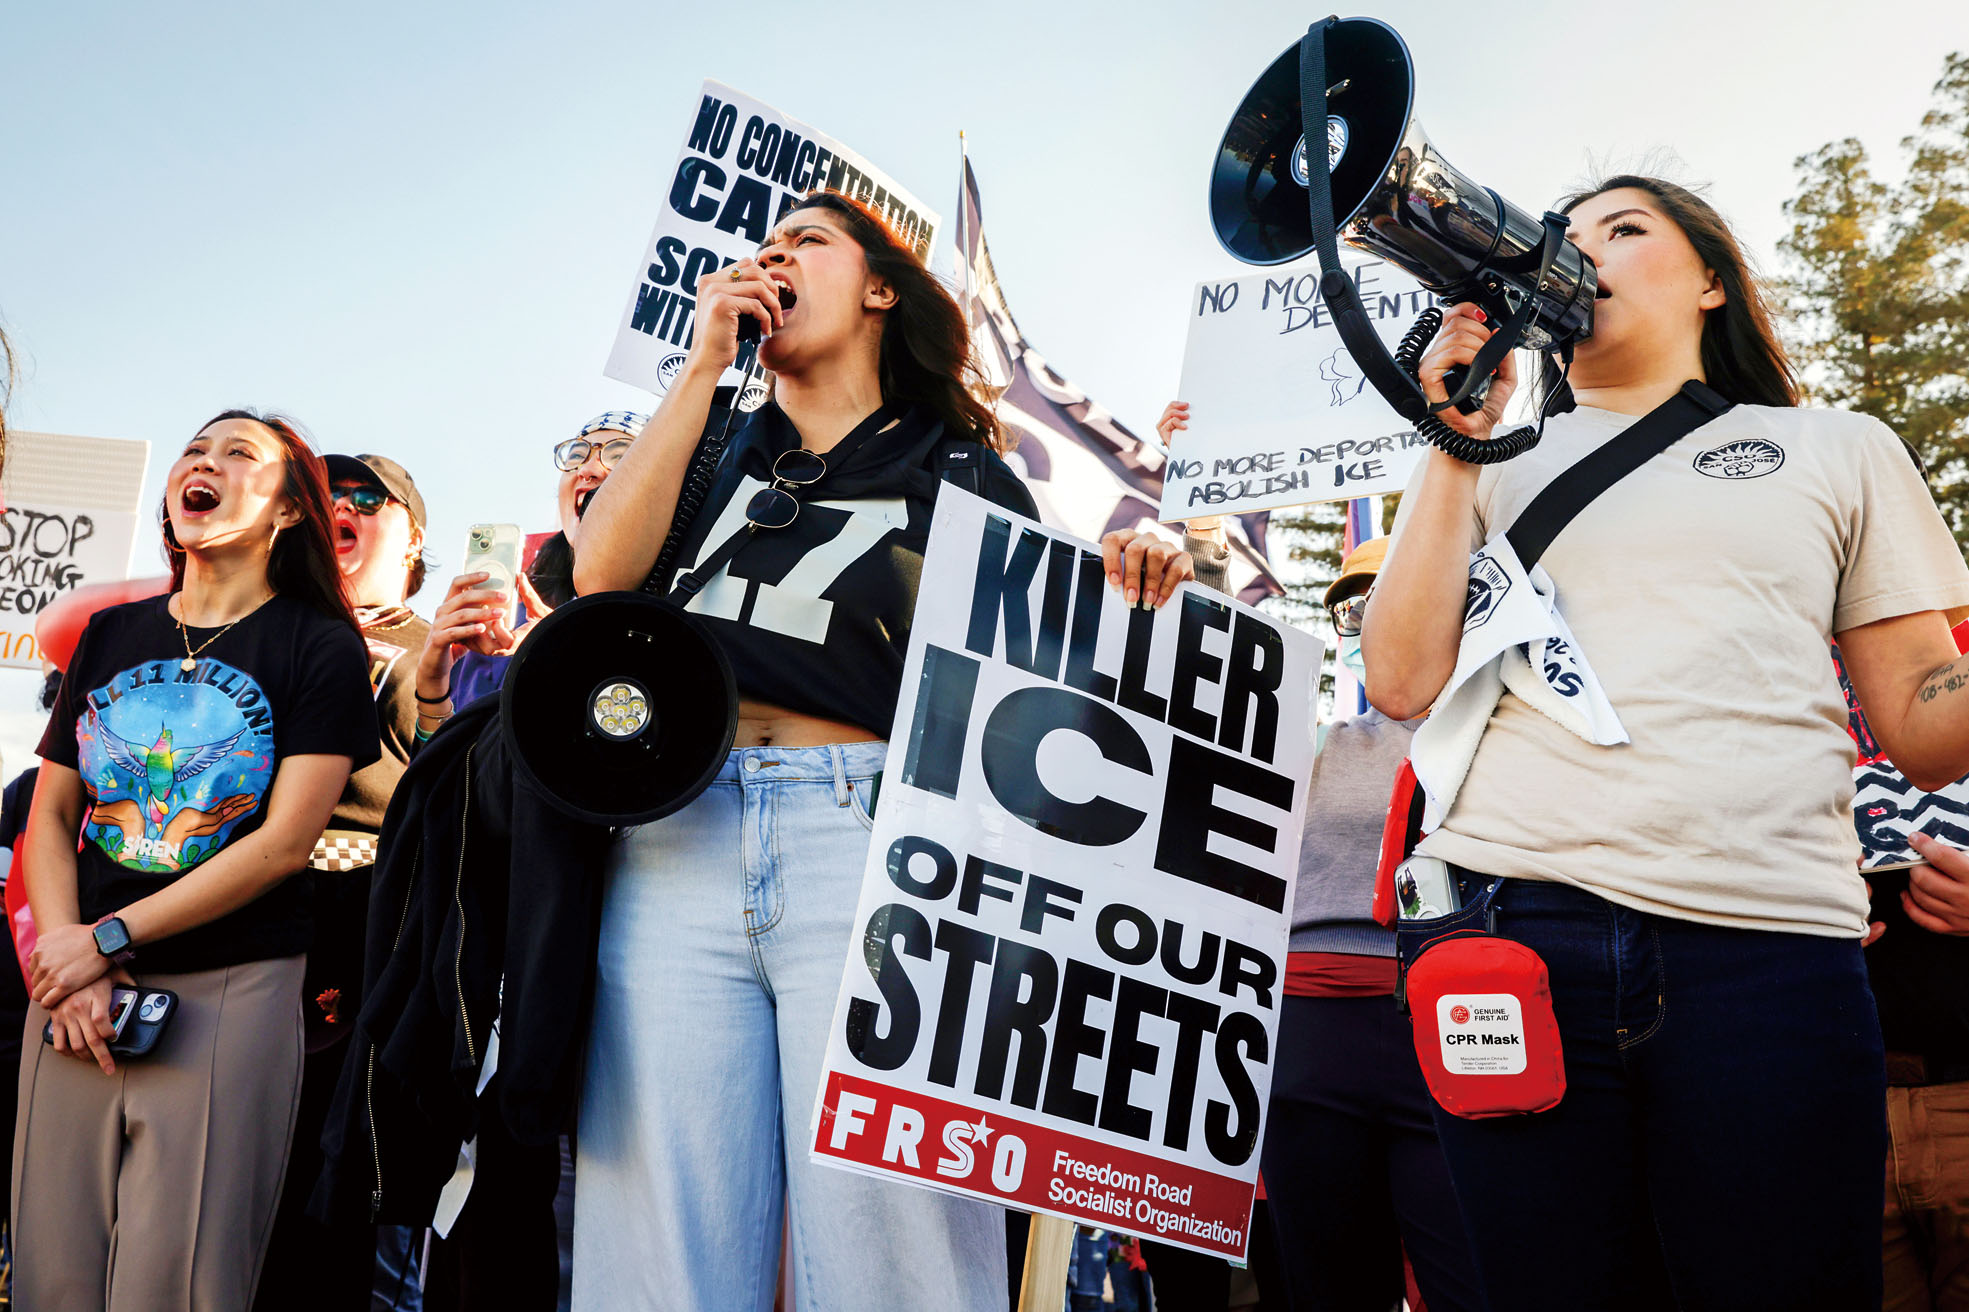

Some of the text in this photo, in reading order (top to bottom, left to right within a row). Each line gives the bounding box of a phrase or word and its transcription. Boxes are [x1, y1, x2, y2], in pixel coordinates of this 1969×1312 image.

[688, 94, 738, 160] NO
[669, 156, 803, 245] CA
[648, 236, 738, 297] SO
[1199, 262, 1384, 316] NO MOE
[1167, 431, 1429, 483] NO MORE DEPORTA
[1188, 459, 1386, 507] ABOLISH ICE
[0, 507, 94, 558] STOP
[965, 512, 1284, 765] KILLER
[129, 664, 165, 690] 11
[901, 643, 1295, 914] ICE
[886, 836, 1277, 1010] OFF OUR
[846, 903, 1269, 1166] STREETS
[1446, 1034, 1520, 1045] CPR Mask
[830, 1090, 1027, 1193] FRSO
[1053, 1150, 1192, 1207] Freedom Road
[1049, 1179, 1242, 1247] Socialist Organization
